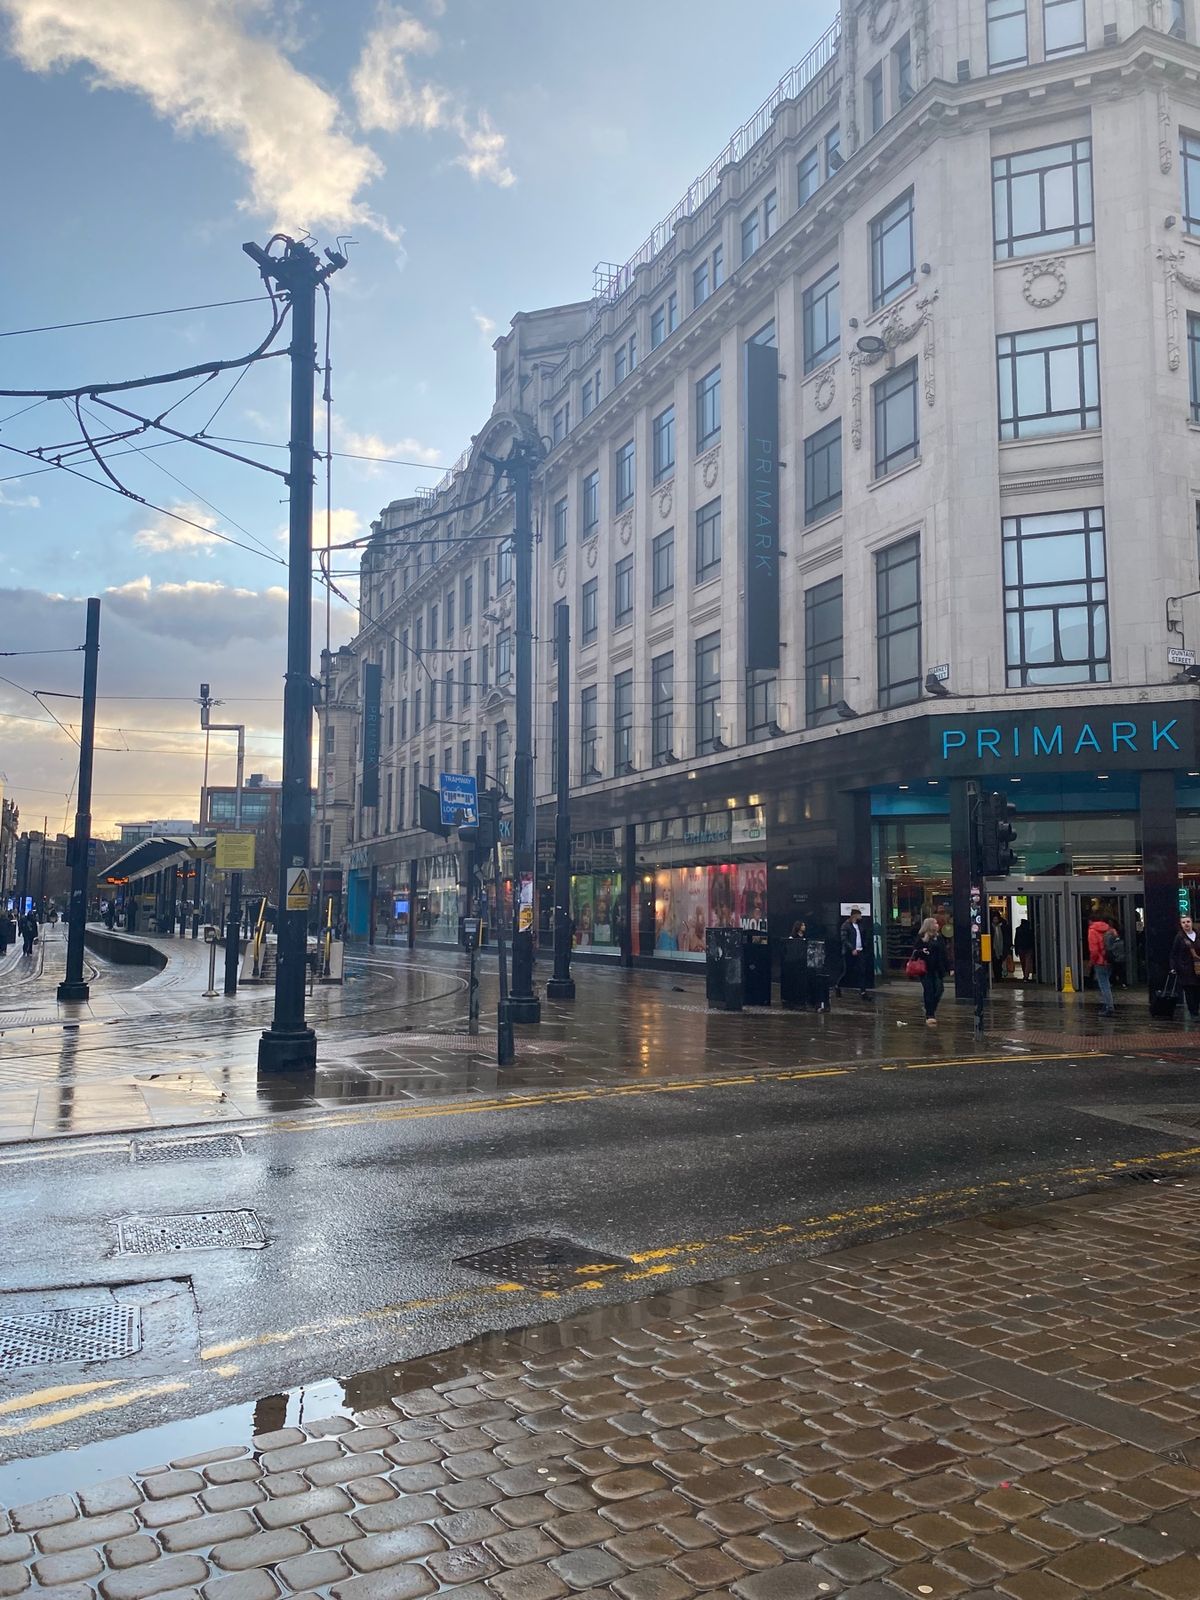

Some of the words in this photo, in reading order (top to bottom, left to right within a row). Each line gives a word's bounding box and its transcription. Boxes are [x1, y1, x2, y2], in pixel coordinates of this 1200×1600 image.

[755, 437, 773, 577] PRIMARK
[1171, 656, 1192, 664] STREET
[943, 719, 1180, 759] PRIMARK
[444, 775, 472, 784] TRAMWAY
